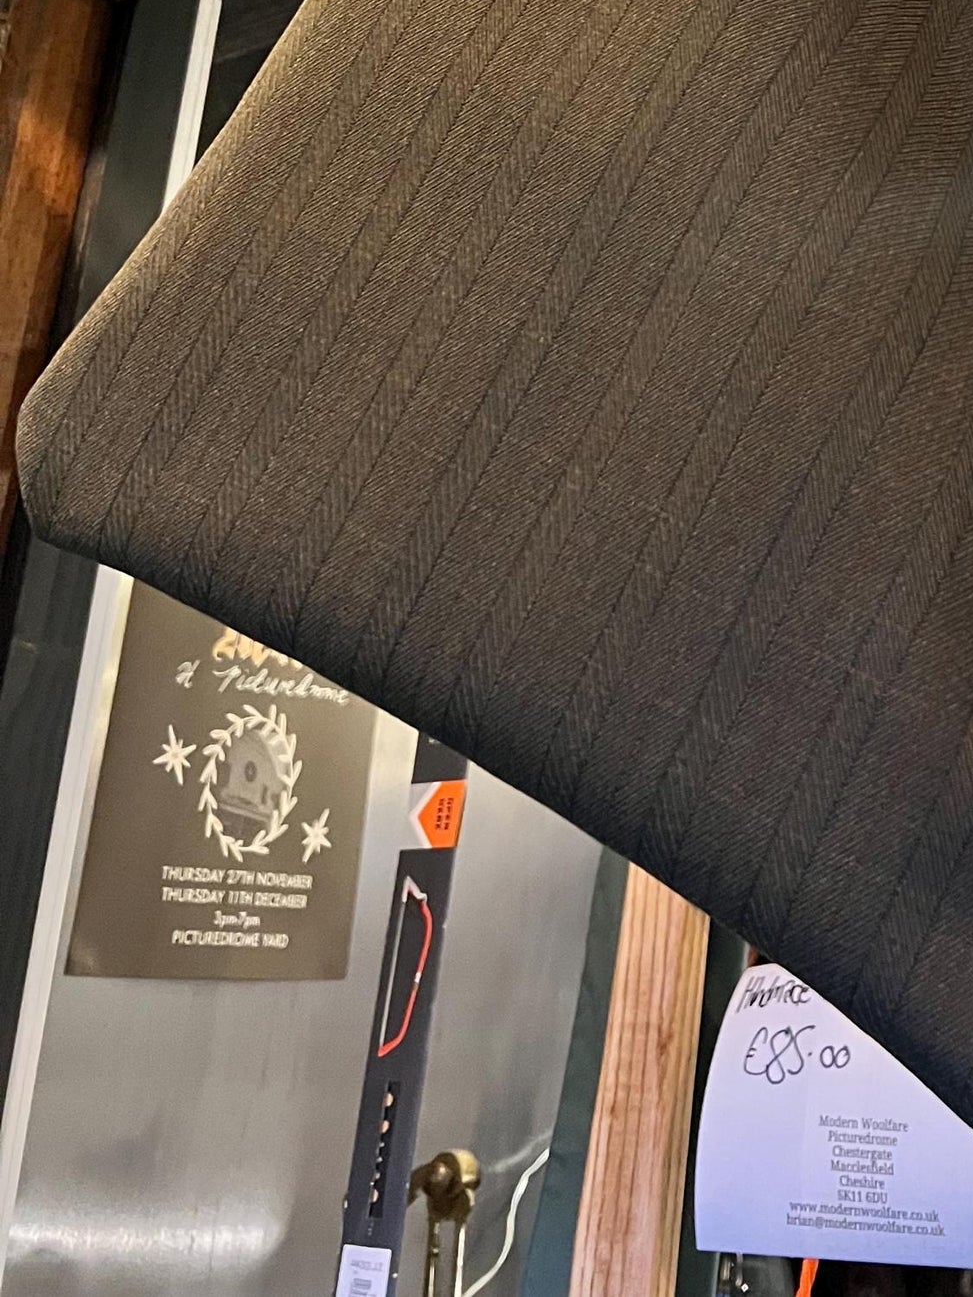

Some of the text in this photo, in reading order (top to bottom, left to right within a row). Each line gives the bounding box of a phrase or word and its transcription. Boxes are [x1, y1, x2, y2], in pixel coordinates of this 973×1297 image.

[161, 865, 314, 890] THURSDAY 27TH NOVEMBER
[161, 886, 308, 909] THURSDAY 11TH DECEMBER
[171, 929, 261, 948] PICTUREDROME
[818, 1114, 909, 1133] Modern Woolfare
[827, 1130, 898, 1146] Picturedrome
[832, 1145, 893, 1162] Chestergate
[830, 1159, 895, 1176] Macclesfield
[839, 1175, 886, 1190] Cheshire
[837, 1189, 863, 1203] SK11
[789, 1201, 940, 1222] www.modernwoolfare.co.uk
[786, 1213, 946, 1236] brian@modernwoolfare.co.uk
